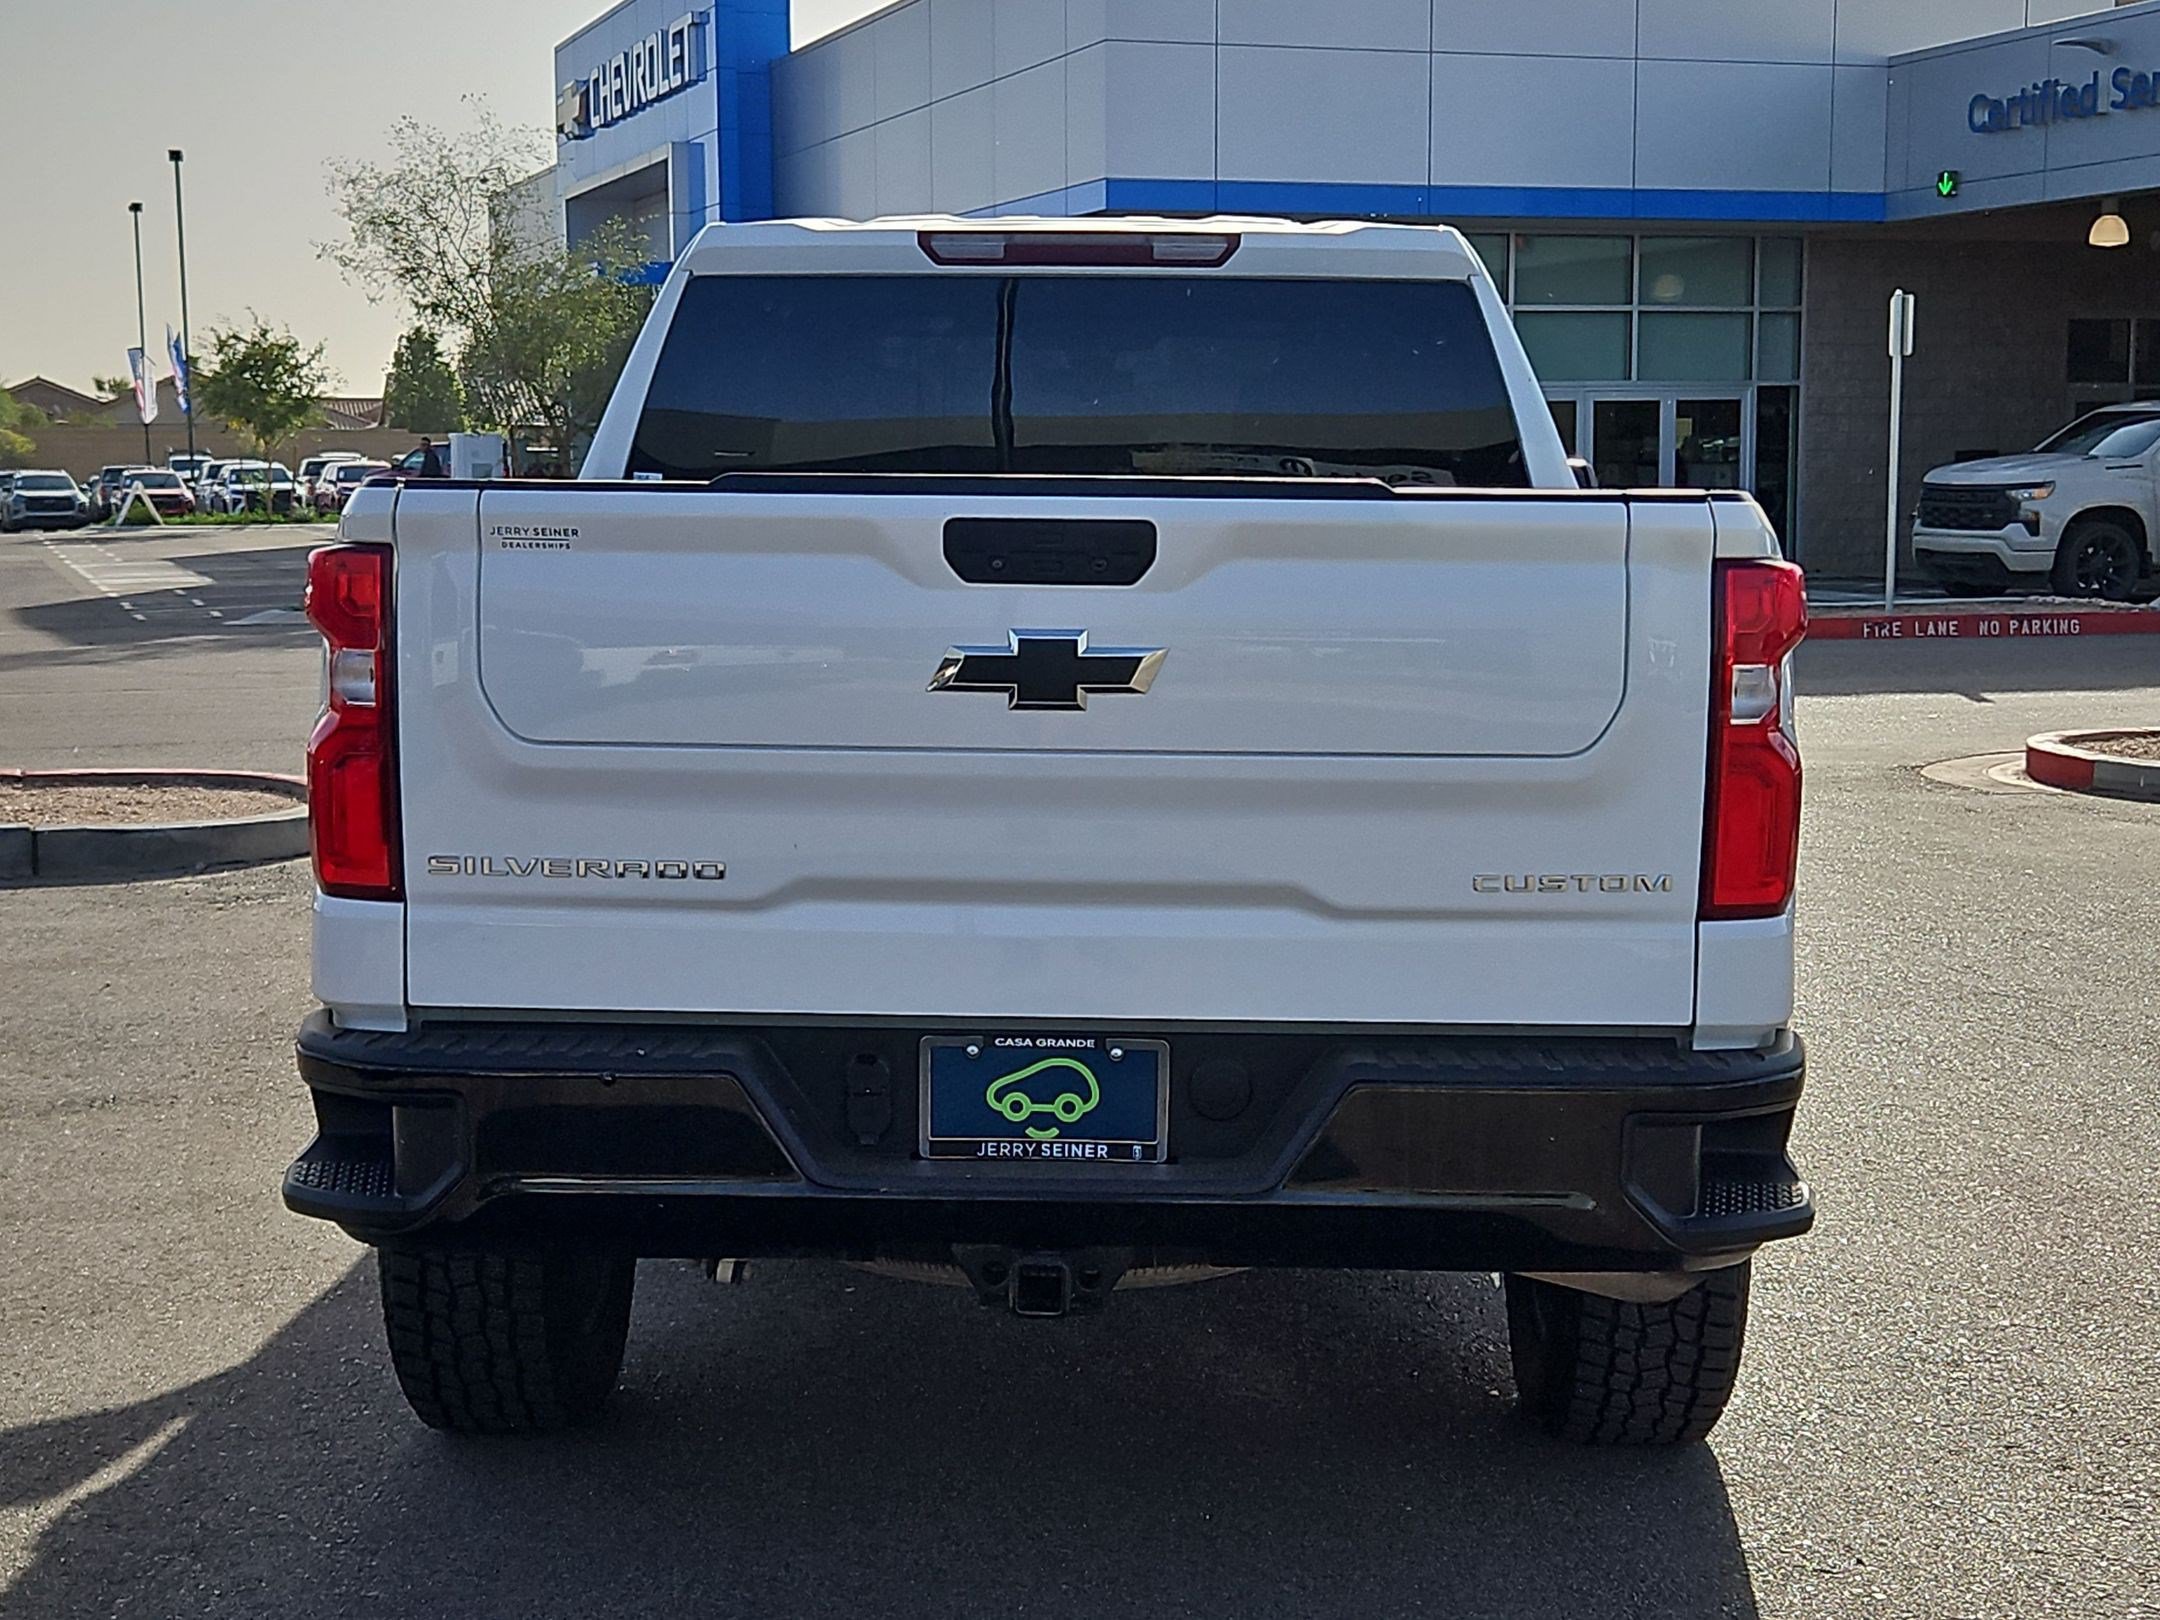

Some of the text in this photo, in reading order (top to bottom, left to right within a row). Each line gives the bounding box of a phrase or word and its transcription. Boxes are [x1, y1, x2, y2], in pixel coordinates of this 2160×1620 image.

[589, 11, 707, 129] CHEVROLET
[1968, 70, 2099, 133] Certified
[489, 526, 580, 538] JERRY SEINER
[501, 541, 571, 550] DEALERSHIPS
[1863, 619, 2081, 639] FIRE LANE NO PARKING
[427, 855, 727, 880] SILVERADO
[1472, 873, 1673, 893] CUSTOM
[994, 1037, 1096, 1049] CASA GRANDE
[976, 1142, 1108, 1159] JERRY SEINER
